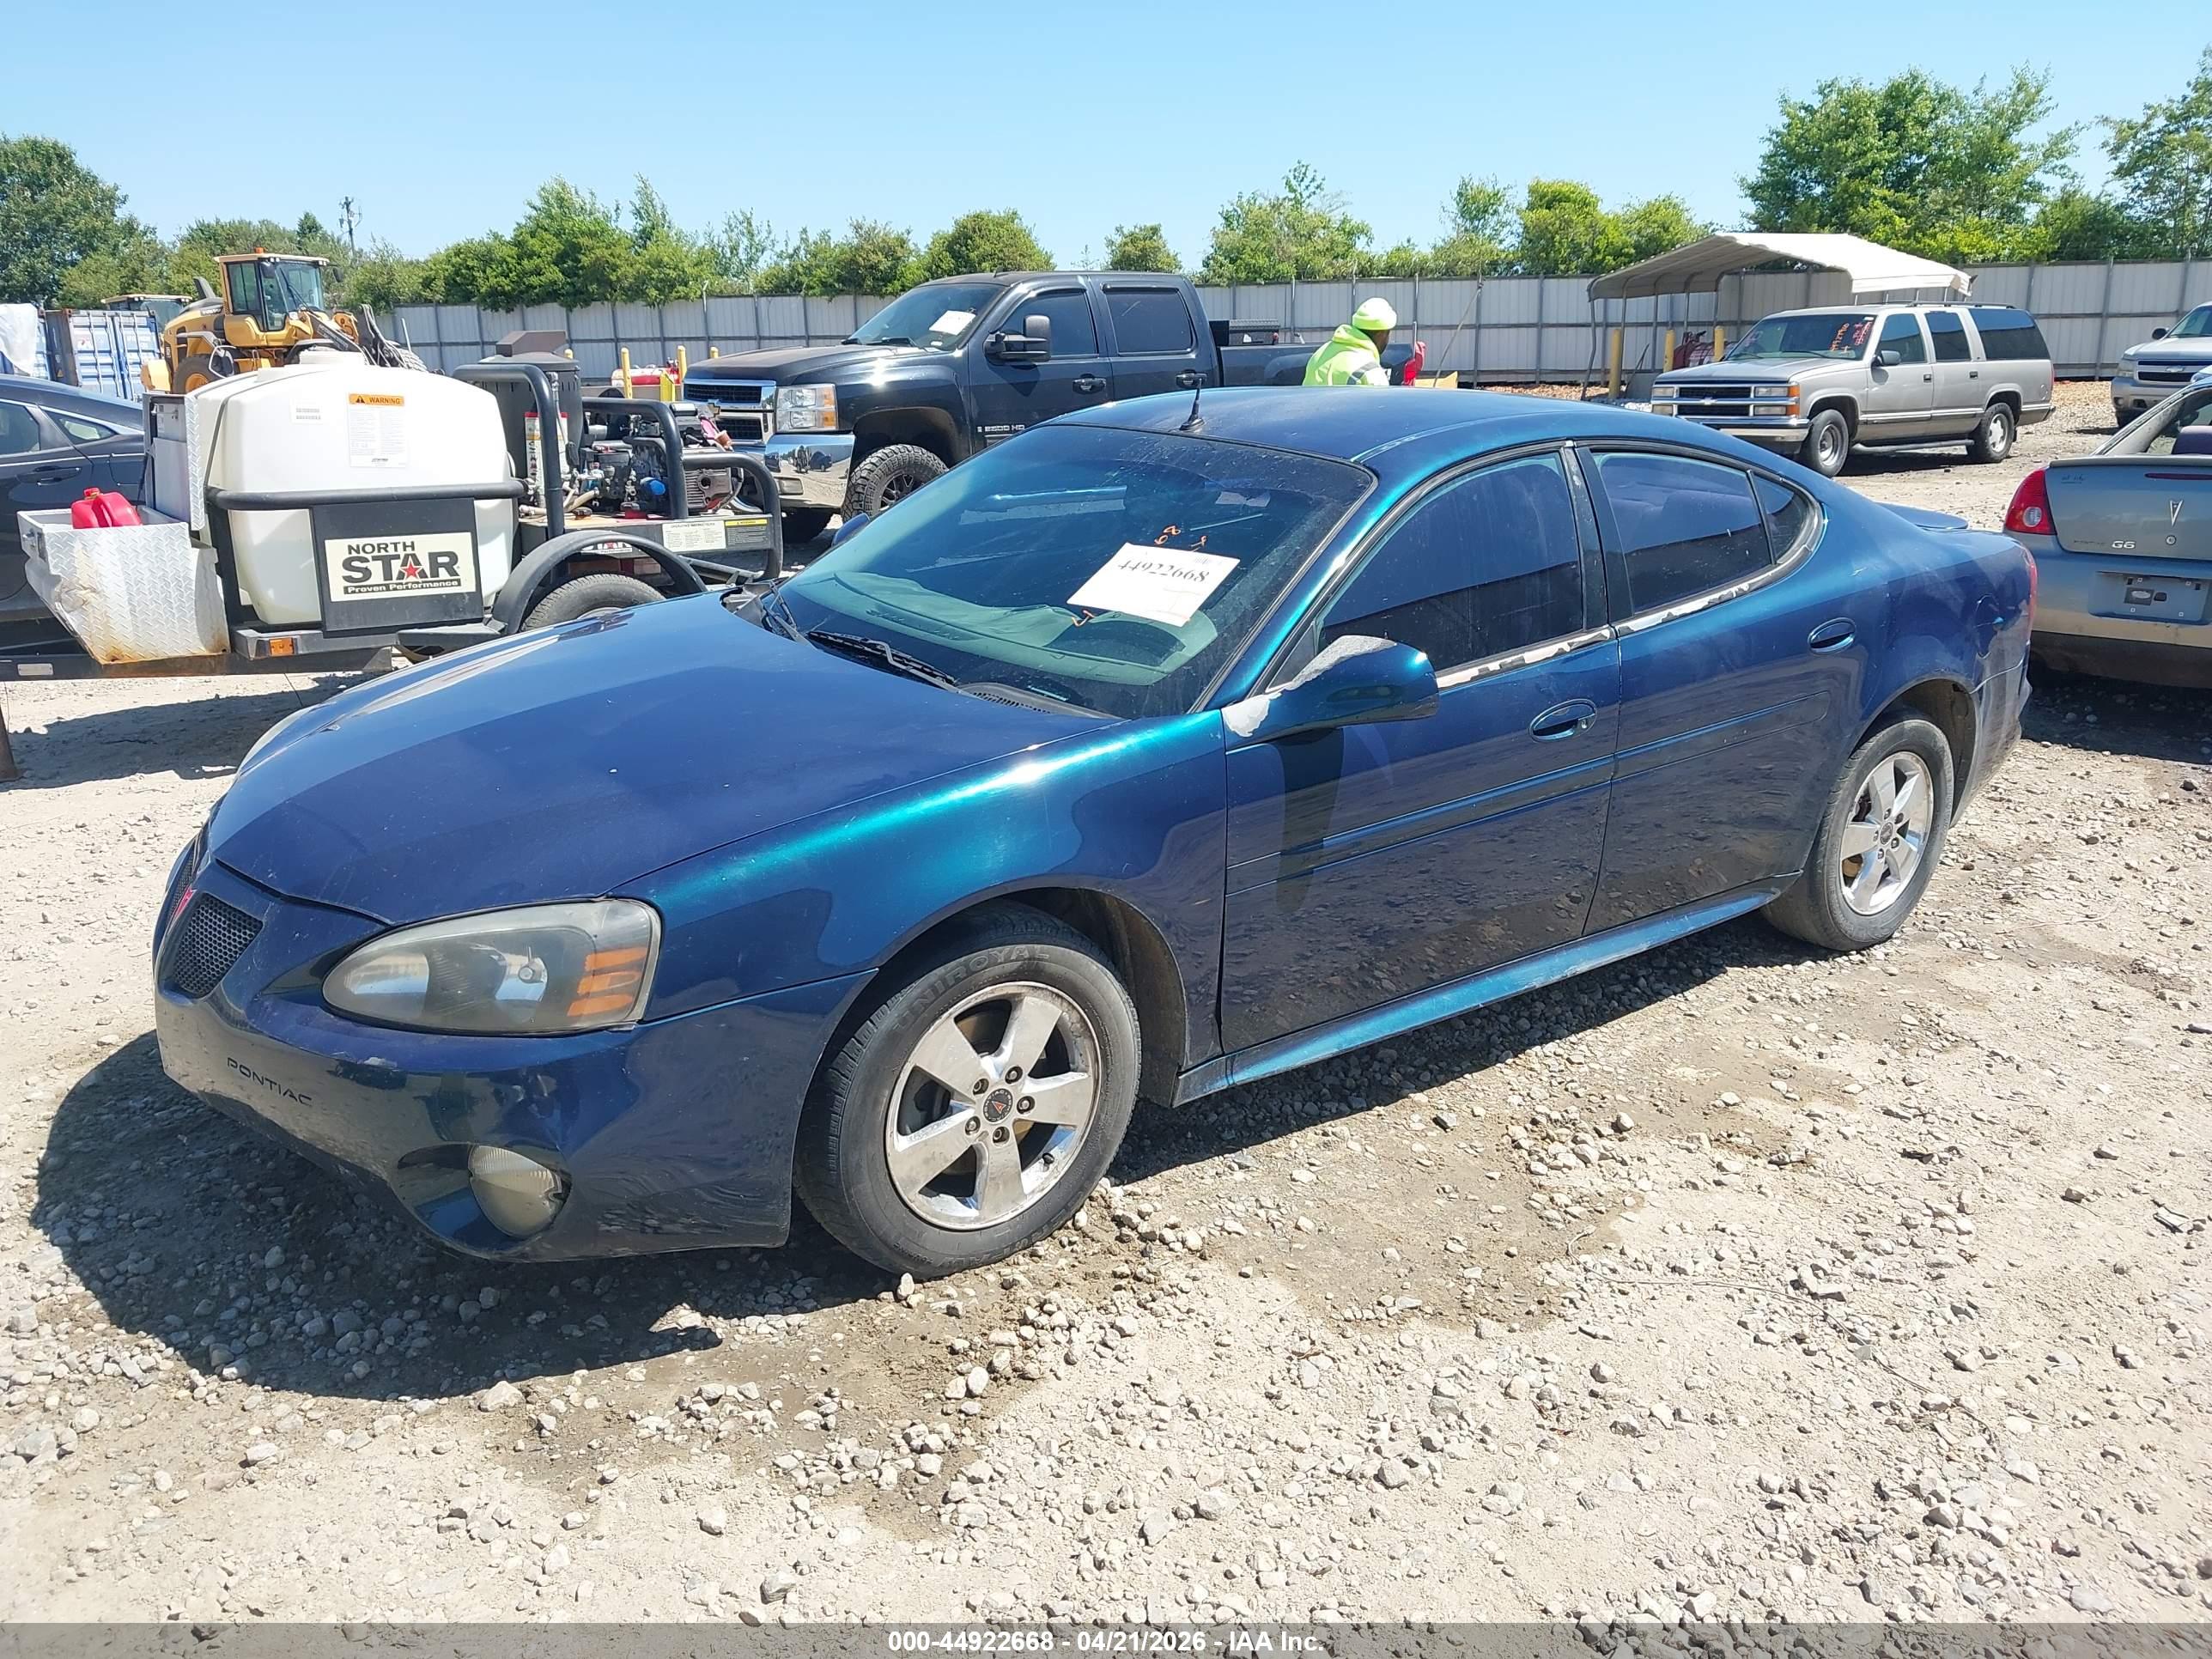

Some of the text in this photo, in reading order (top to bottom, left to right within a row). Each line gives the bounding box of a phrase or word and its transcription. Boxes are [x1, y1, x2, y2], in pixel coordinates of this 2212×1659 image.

[368, 396, 401, 404] WARNING
[348, 541, 416, 555] NORTH
[2112, 540, 2136, 549] G6
[342, 550, 460, 584] STAR
[1118, 559, 1210, 582] 44922668
[347, 580, 459, 593] Proven Performance
[228, 1056, 313, 1107] PONTIAC
